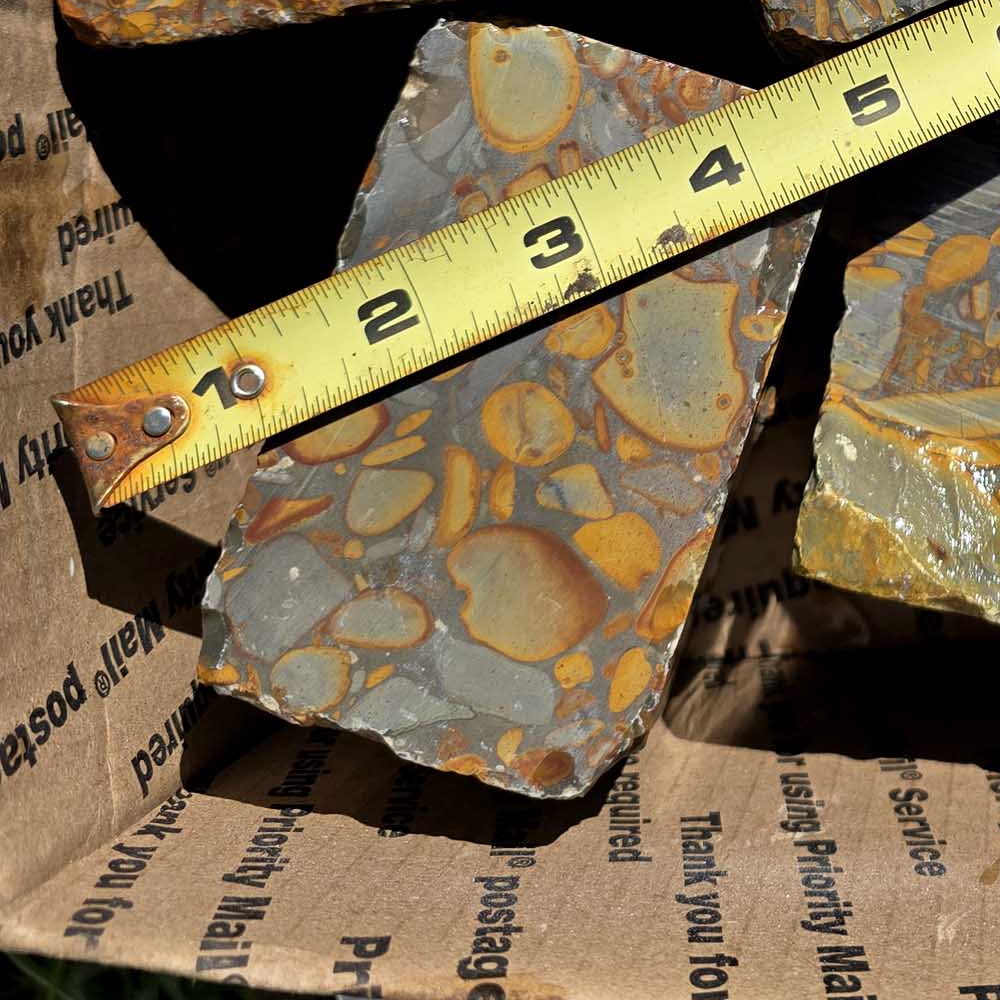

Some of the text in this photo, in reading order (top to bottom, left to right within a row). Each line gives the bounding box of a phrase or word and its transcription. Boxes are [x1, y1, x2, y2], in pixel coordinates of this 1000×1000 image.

[356, 287, 422, 346] 2
[522, 215, 585, 270] 3
[688, 144, 747, 194] 4
[842, 73, 902, 127] 5
[44, 269, 135, 343] Thank
[607, 771, 653, 864] required
[779, 771, 826, 834] using
[886, 786, 948, 879] Service
[95, 842, 159, 890] you
[222, 803, 314, 889] Priority
[680, 811, 729, 887] Thank
[675, 892, 725, 944] you
[793, 839, 854, 937] Priority
